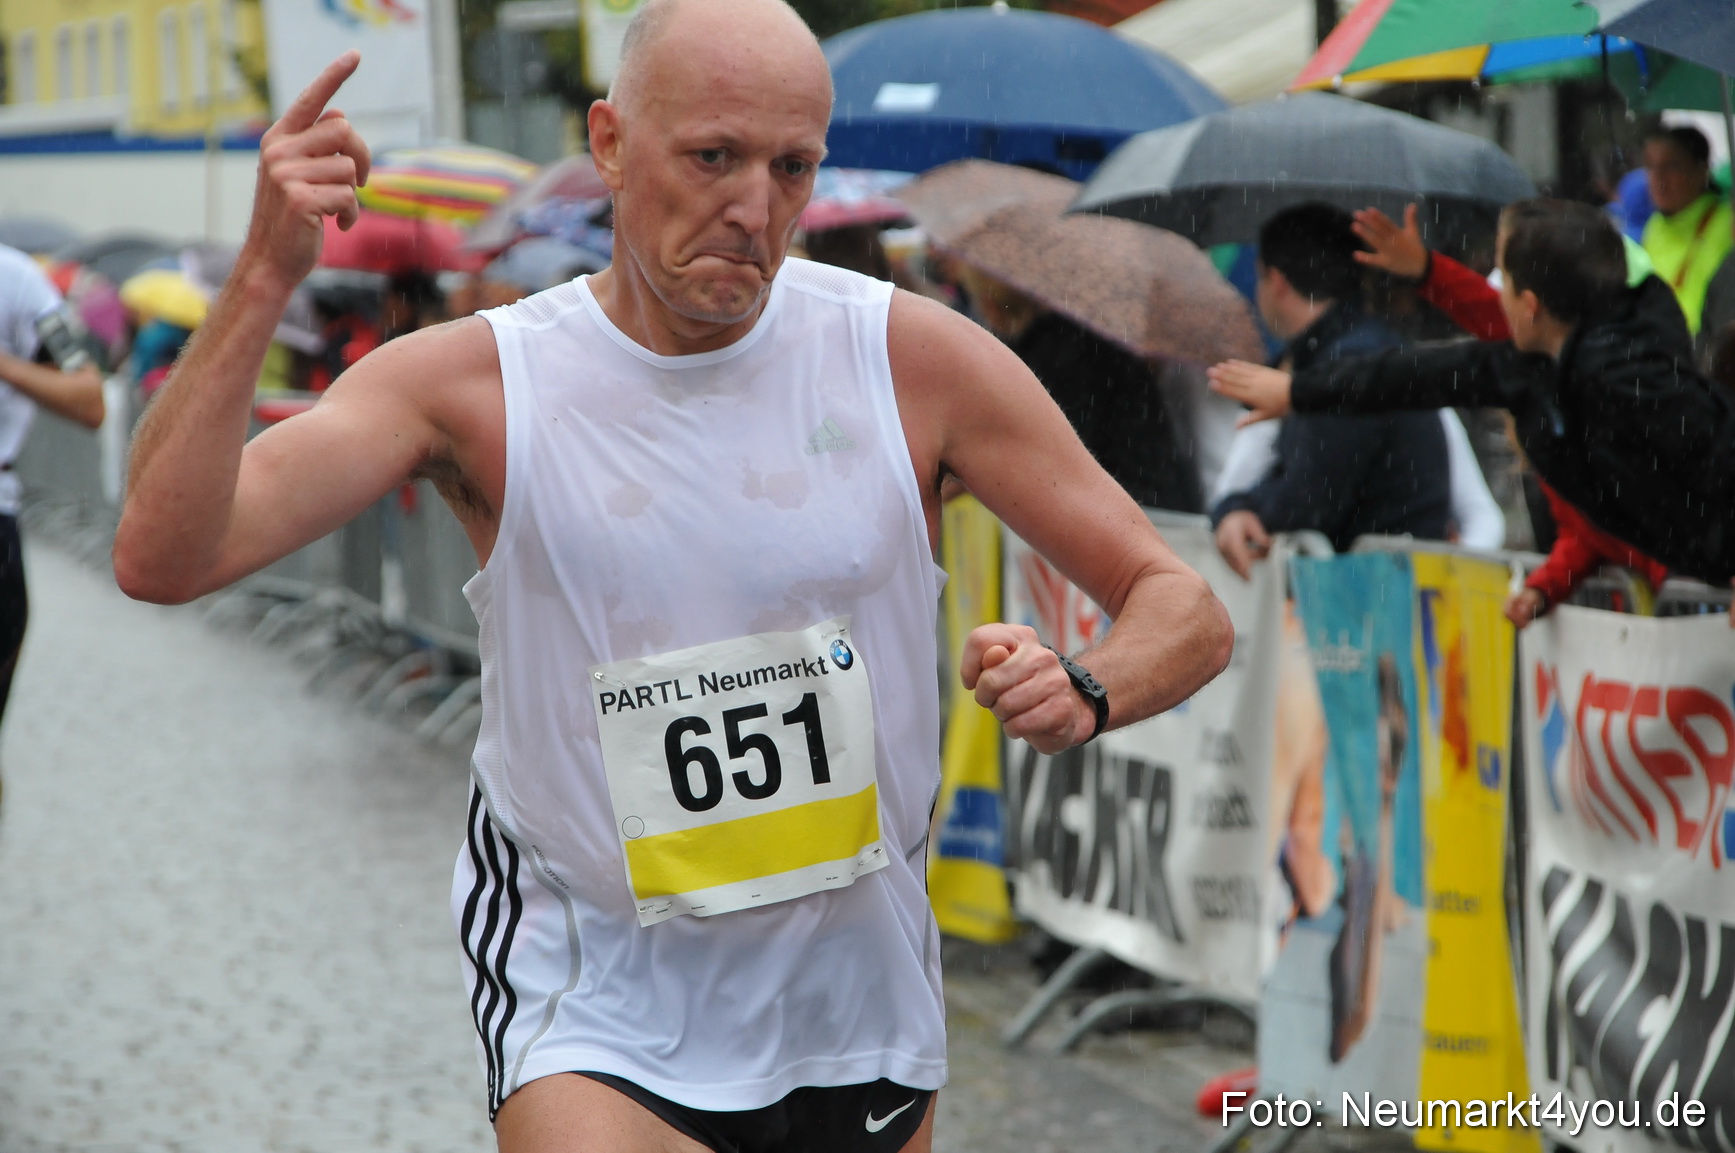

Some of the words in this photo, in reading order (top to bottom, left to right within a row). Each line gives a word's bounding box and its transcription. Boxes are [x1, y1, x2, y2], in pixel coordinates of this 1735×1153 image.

[599, 680, 693, 715] PARTL
[698, 655, 829, 696] Neumarkt
[664, 691, 832, 813] 651
